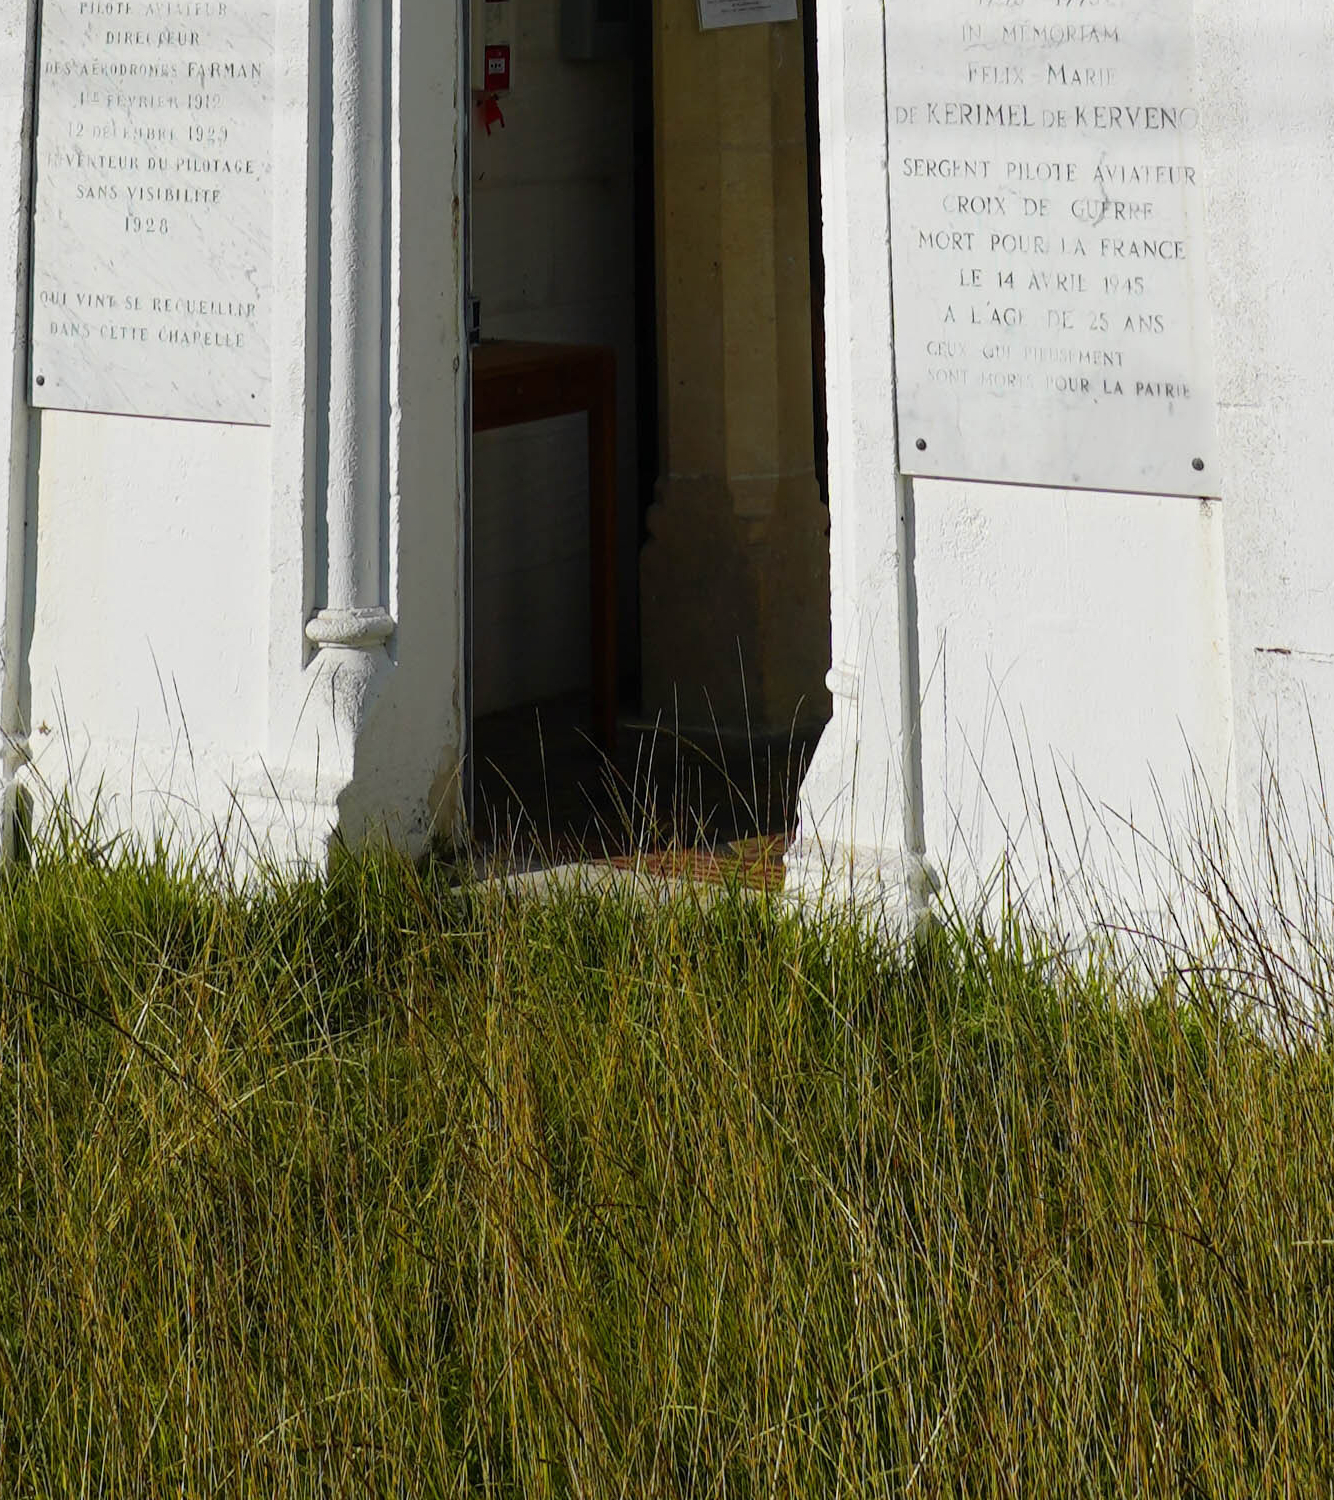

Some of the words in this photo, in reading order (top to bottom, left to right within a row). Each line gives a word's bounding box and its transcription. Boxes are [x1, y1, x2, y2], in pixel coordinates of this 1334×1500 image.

[80, 2, 132, 15] PILOTE
[146, 2, 227, 17] AVIATEUR
[106, 31, 200, 46] DIRECTEUR
[962, 25, 982, 42] IN
[45, 61, 71, 76] DES
[188, 61, 262, 79] FARMAN
[896, 106, 917, 125] DE
[927, 102, 1036, 128] KERIMEL
[1043, 109, 1068, 128] DE
[1075, 105, 1198, 130] KERVENO
[69, 123, 84, 137] 12
[48, 154, 139, 170] INVENTEUR
[147, 157, 168, 172] DU
[176, 158, 254, 175] PILOTAGE
[903, 157, 990, 178] SERGENT
[1007, 162, 1077, 182] PILOTE
[1093, 164, 1196, 186] AVIATEUR
[76, 184, 118, 200] SANS
[942, 195, 1006, 216] CROIX
[1024, 198, 1051, 217] DE
[1071, 199, 1153, 221] GUERRE
[125, 216, 169, 234] 1928
[919, 231, 974, 251] MORT
[991, 233, 1045, 254] POUR
[1062, 237, 1086, 257] LA
[1101, 238, 1187, 260] FRANCE
[960, 268, 982, 287] LE
[997, 271, 1014, 289] 14
[1028, 272, 1086, 293] AVRIL
[1104, 275, 1145, 295] 1945
[40, 291, 67, 307] QUI
[77, 293, 115, 308] VINT
[125, 296, 141, 311] SE
[153, 298, 256, 317] RECUEILLIR
[943, 304, 956, 324] A
[1048, 309, 1075, 330] DE
[1089, 311, 1109, 332] 25
[1123, 314, 1165, 333] ANS
[51, 322, 90, 338] DANS
[100, 325, 148, 341] CETTE
[159, 327, 244, 348] CHAPELLE
[927, 340, 966, 358] CEUX
[982, 344, 1010, 360] QUI
[1024, 346, 1124, 367] PIEUSEMENT
[928, 368, 968, 384] SONT
[1046, 374, 1090, 393] POUR
[1103, 379, 1123, 396] LA
[1136, 381, 1191, 399] PATRIE
